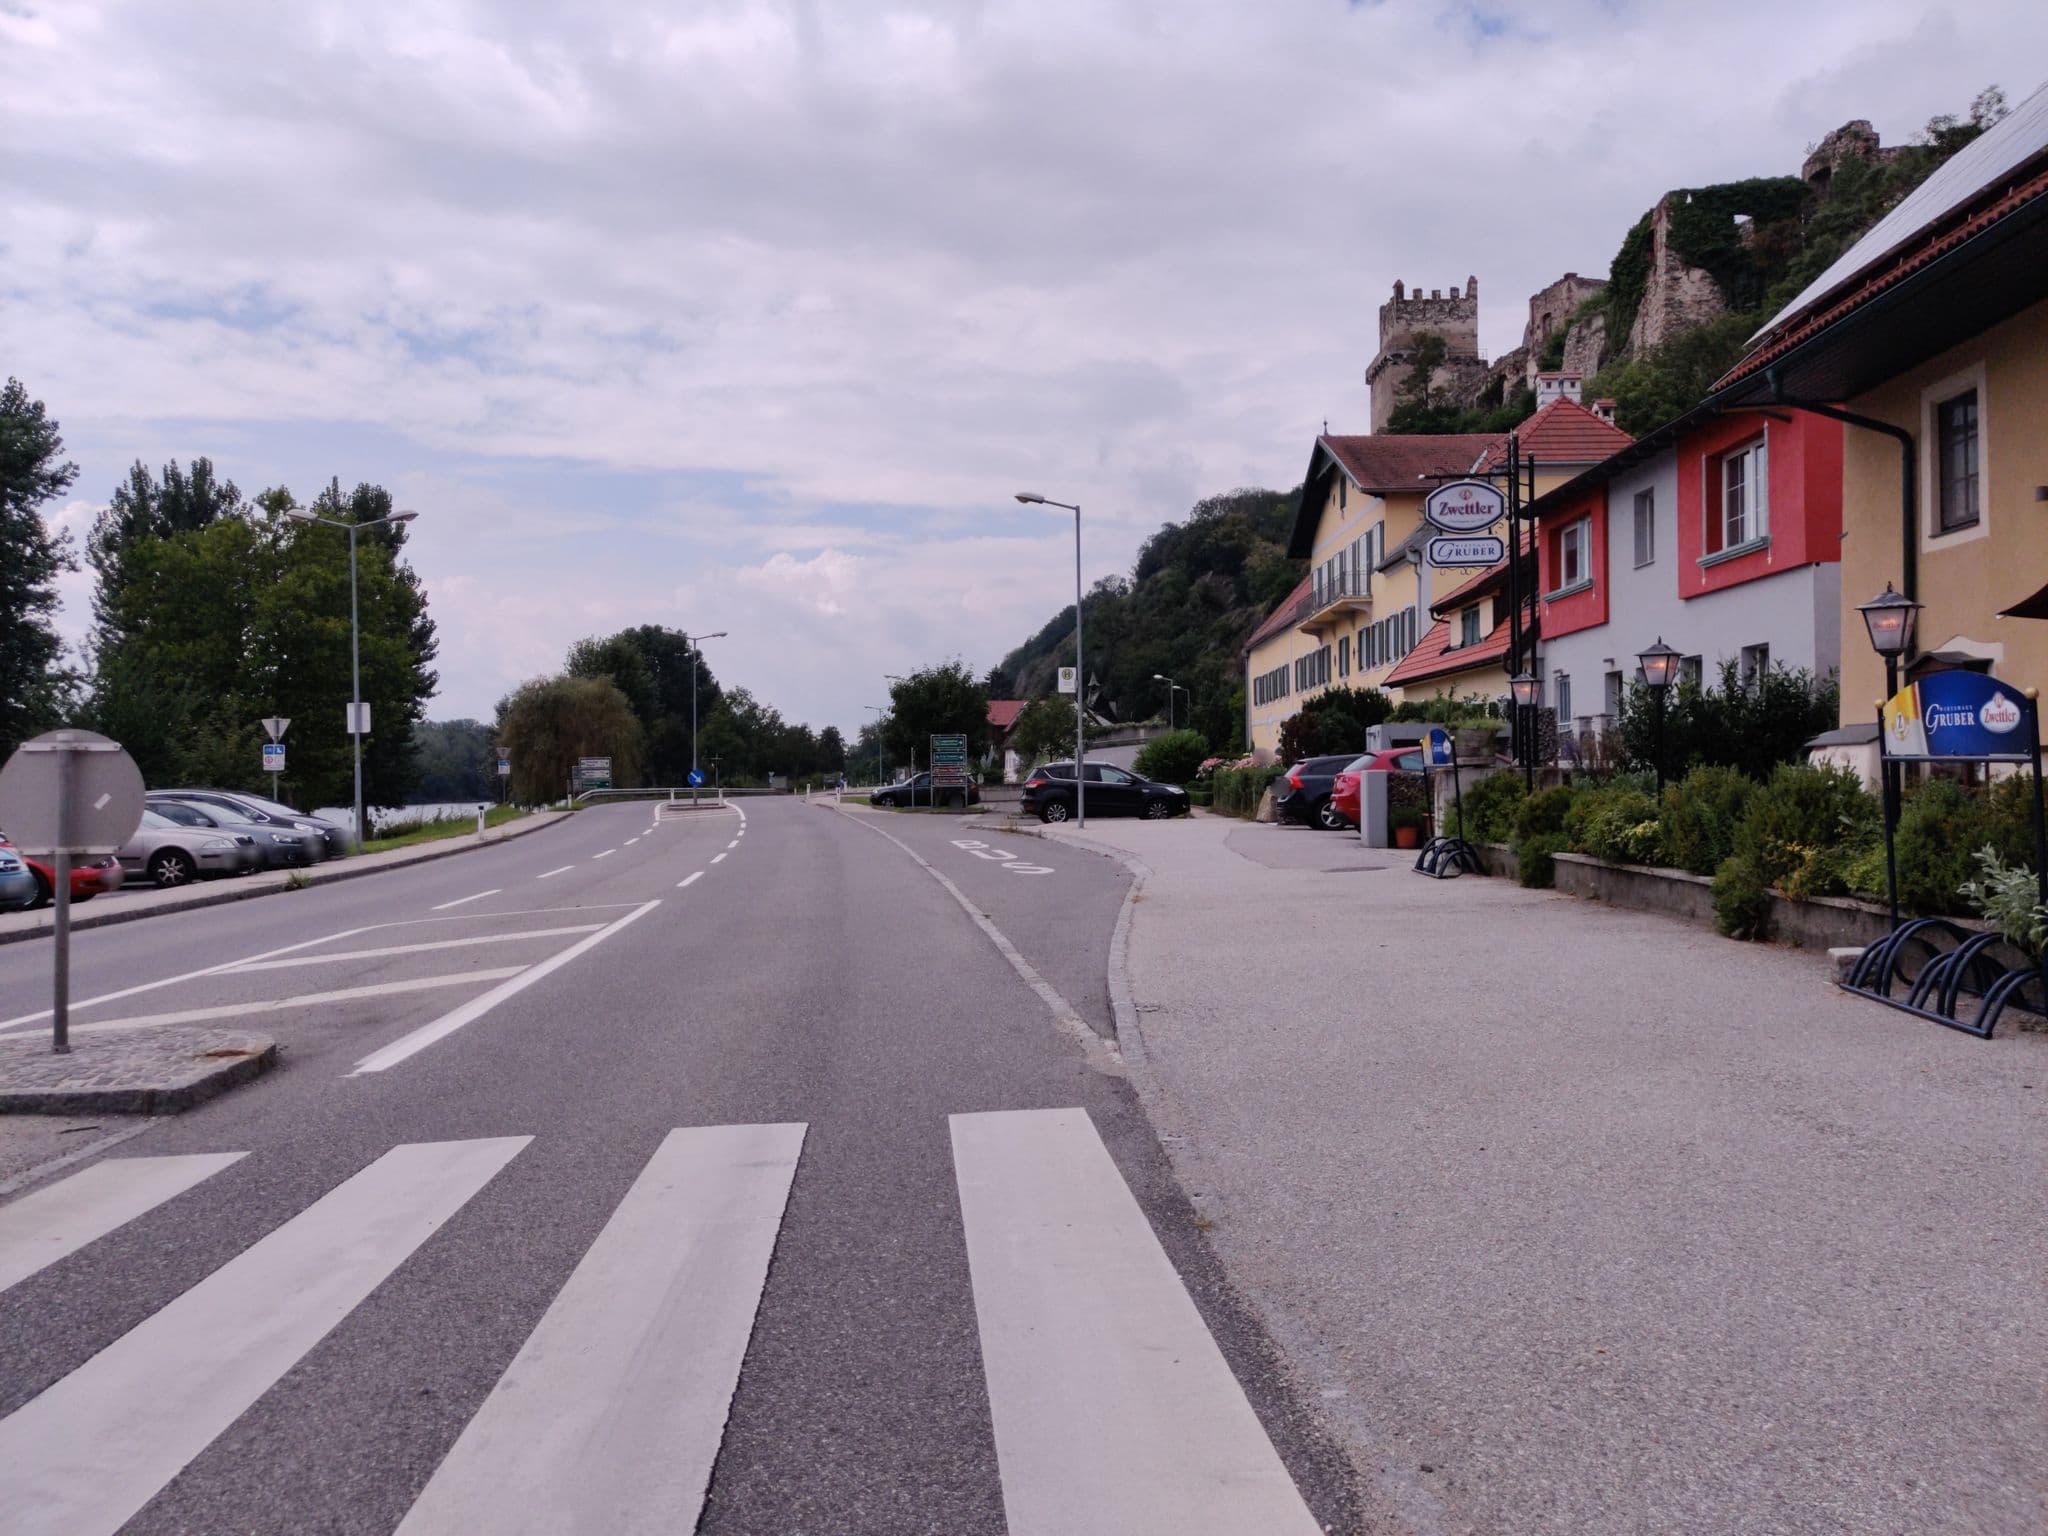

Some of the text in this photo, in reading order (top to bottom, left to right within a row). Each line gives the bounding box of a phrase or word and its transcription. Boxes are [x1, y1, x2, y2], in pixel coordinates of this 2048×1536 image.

[1439, 501, 1495, 516] Zwettler
[1438, 542, 1495, 560] GRUBER
[1925, 703, 1976, 735] GRUBER
[1984, 707, 2017, 723] Zwettler
[950, 839, 1055, 875] BUS
